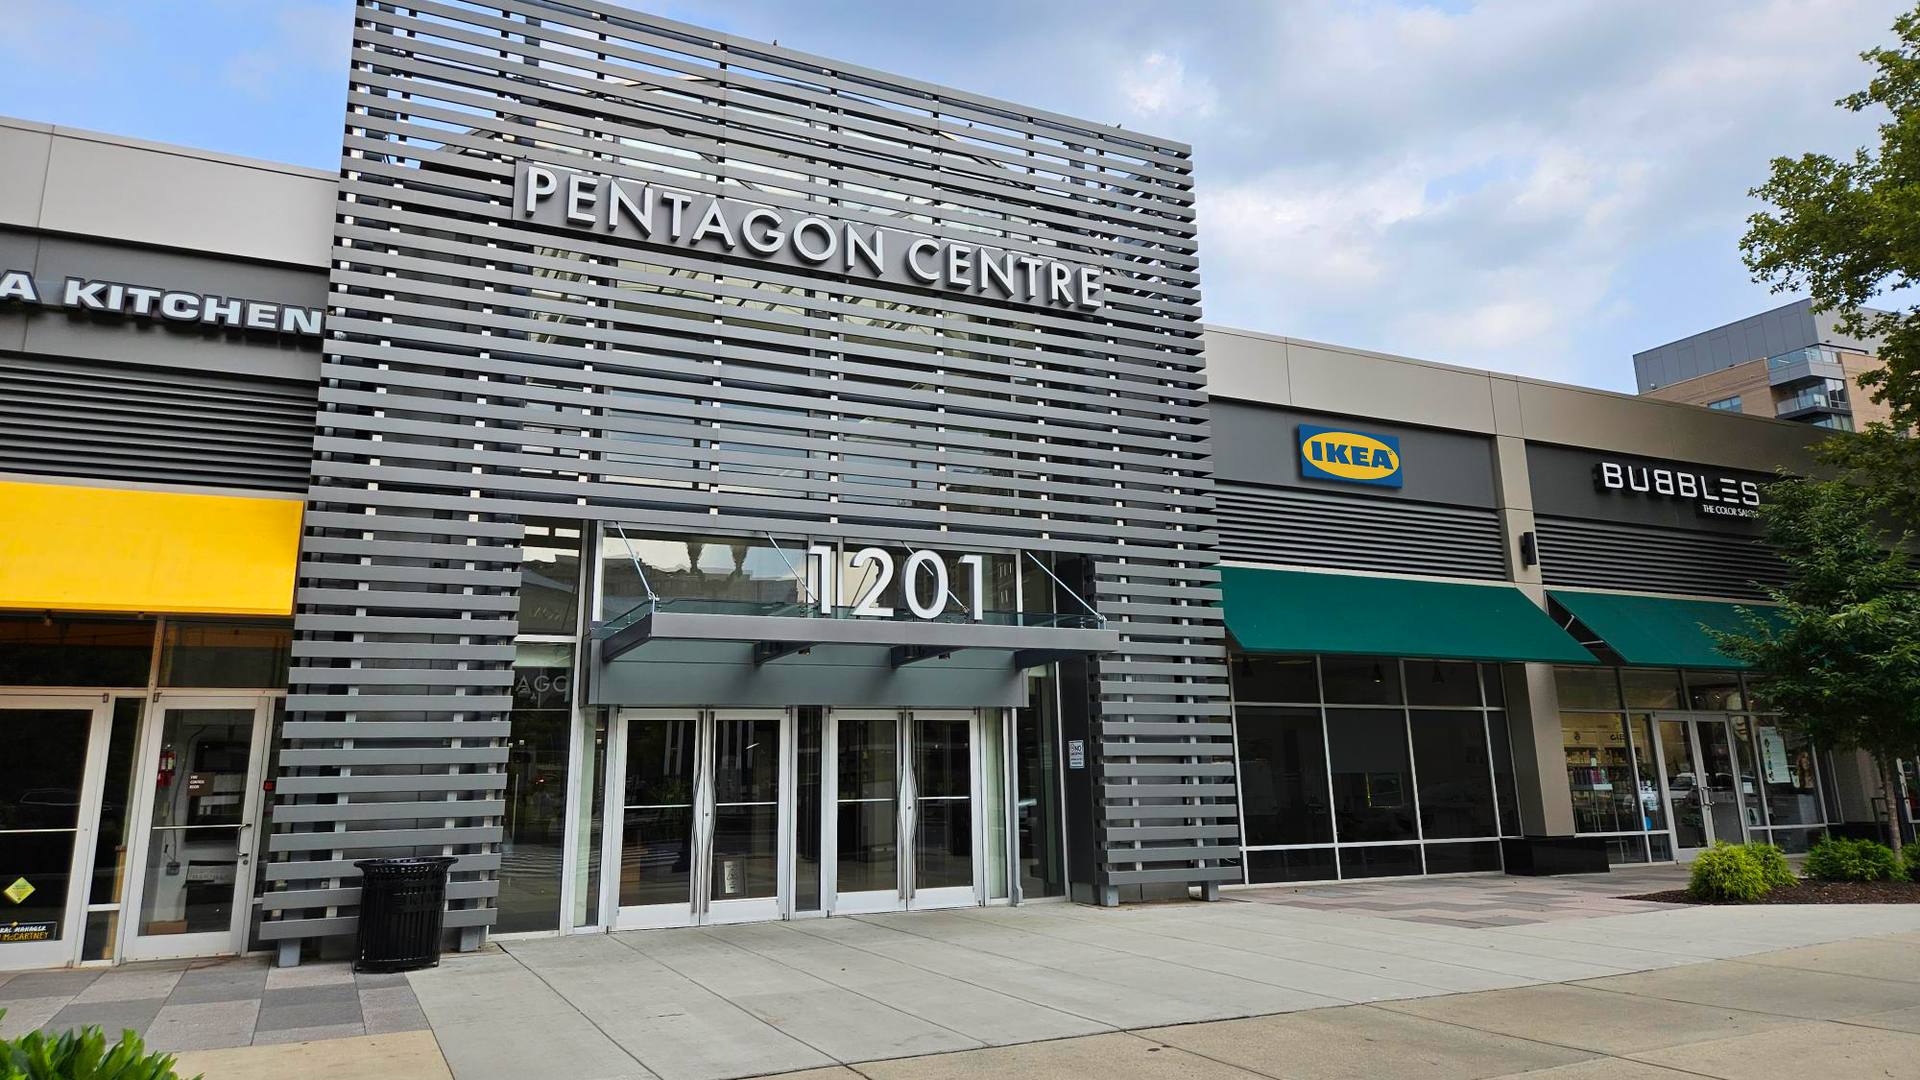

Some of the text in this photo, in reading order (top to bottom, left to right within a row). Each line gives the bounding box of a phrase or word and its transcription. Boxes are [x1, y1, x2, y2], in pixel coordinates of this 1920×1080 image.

[525, 166, 1102, 310] PENTAGON CENTRE
[0, 271, 324, 335] A KITCHEN
[1311, 440, 1394, 470] IKEA
[1602, 462, 1760, 506] BUBBLES
[1703, 504, 1715, 514] THE
[1715, 505, 1737, 516] COLOR
[807, 545, 984, 620] 1201
